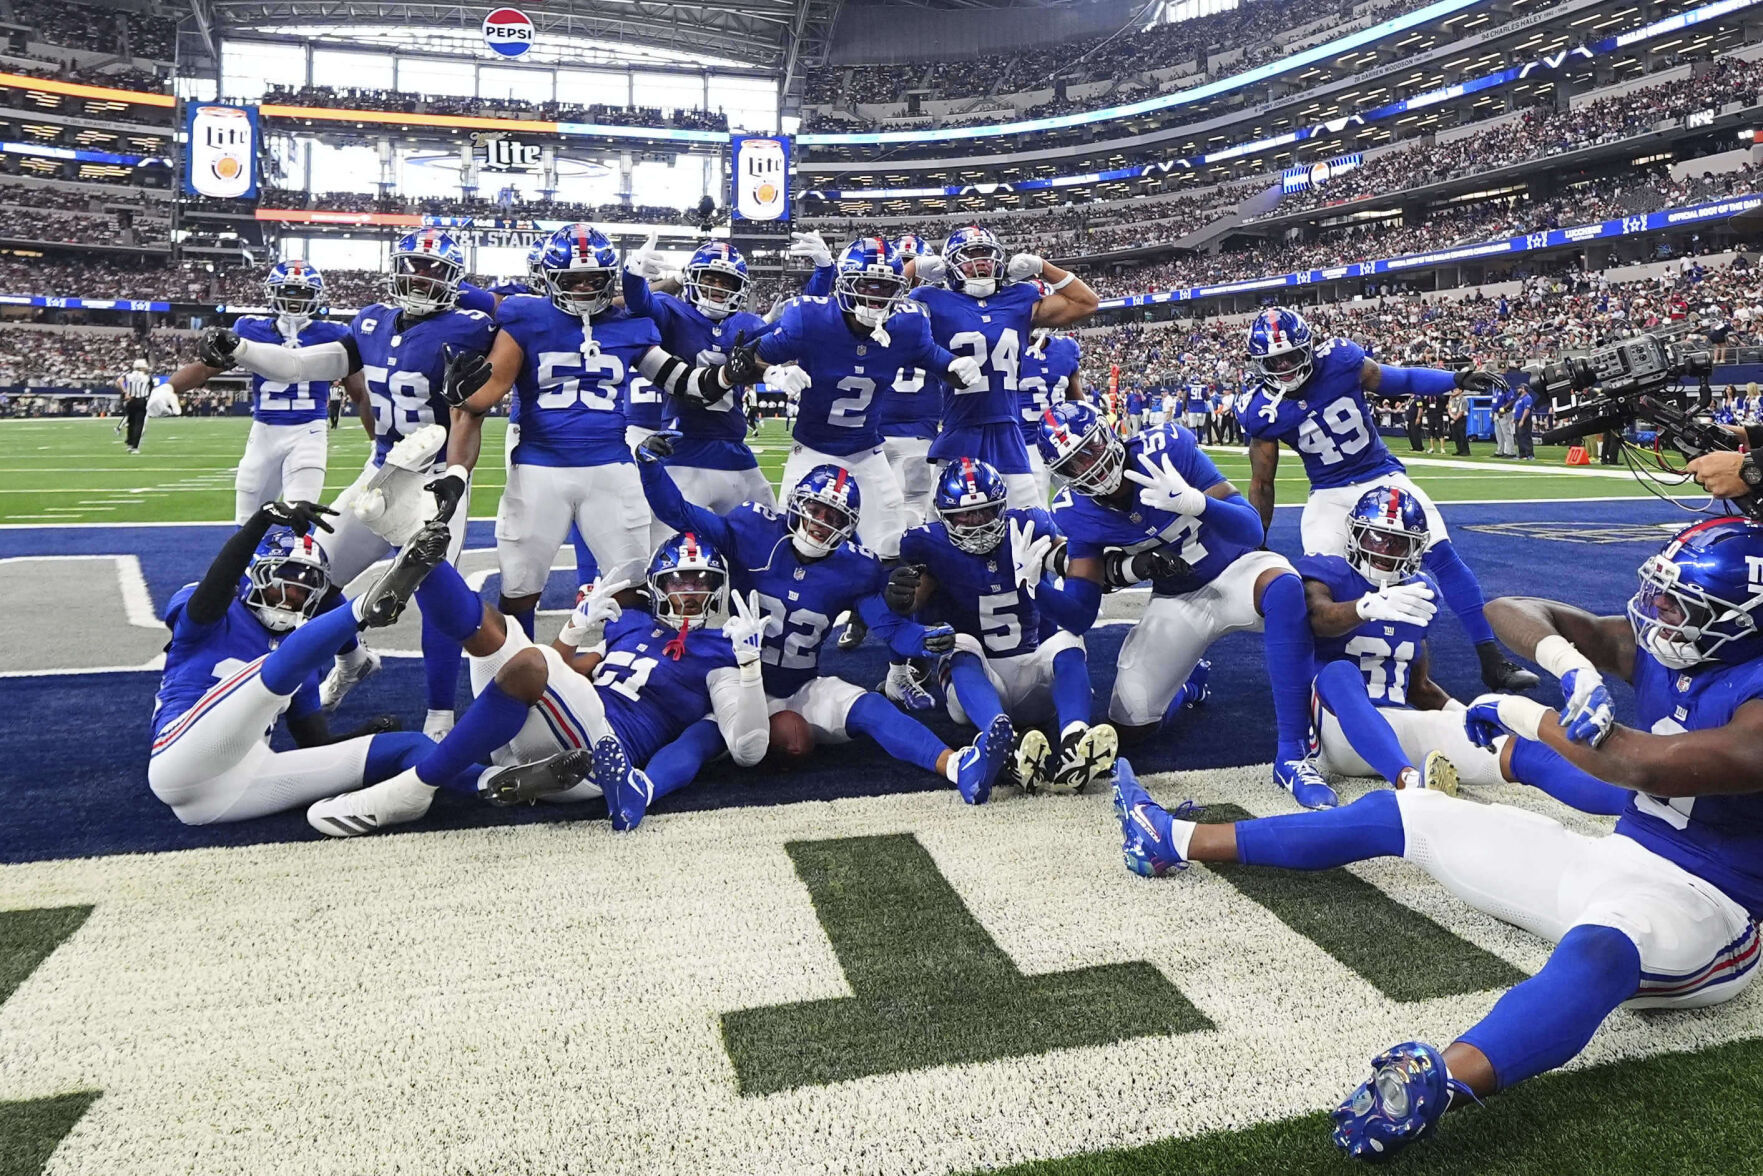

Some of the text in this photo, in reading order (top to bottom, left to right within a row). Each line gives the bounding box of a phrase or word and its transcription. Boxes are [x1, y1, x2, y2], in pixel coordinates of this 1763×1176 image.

[486, 27, 532, 40] PEPSI
[1490, 23, 1520, 39] CHARLES
[1520, 14, 1543, 28] HALEY
[1384, 58, 1414, 73] WOODSON
[486, 139, 543, 170] Lite
[1668, 210, 1699, 223] OFFICIAL
[1718, 204, 1729, 214] OF
[1729, 202, 1744, 212] THE
[571, 245, 597, 259] 53
[361, 318, 378, 333] C
[949, 328, 1020, 394] 24
[259, 381, 316, 411] 21
[537, 352, 625, 411] 53
[363, 364, 436, 437] 58
[827, 375, 876, 428] 2
[1298, 396, 1369, 466] 49
[1567, 447, 1585, 464] 10
[967, 480, 977, 495] 5
[679, 545, 702, 558] 51
[759, 591, 829, 669] 22
[979, 590, 1022, 652] 5
[1345, 635, 1415, 704] 31
